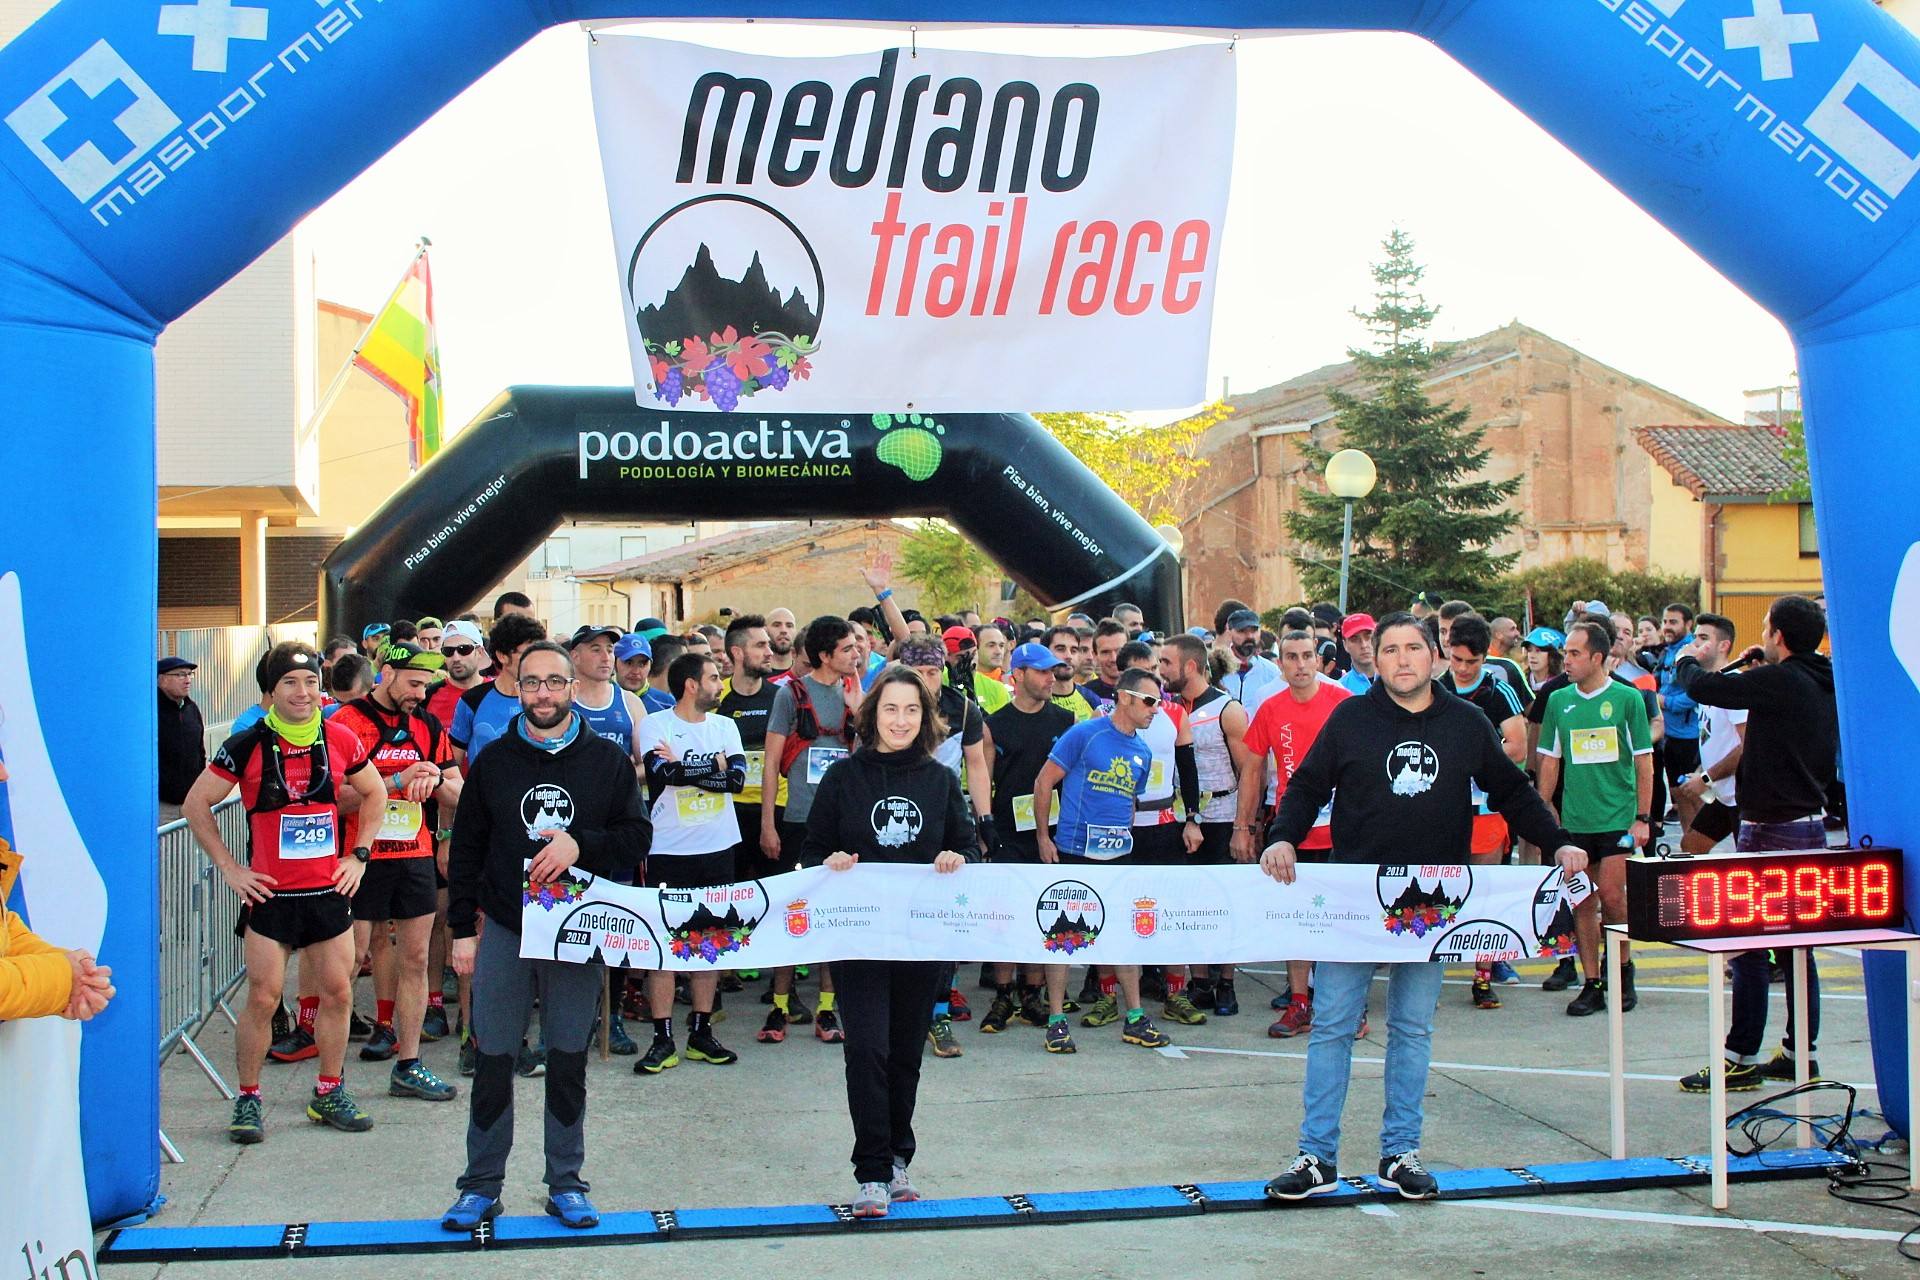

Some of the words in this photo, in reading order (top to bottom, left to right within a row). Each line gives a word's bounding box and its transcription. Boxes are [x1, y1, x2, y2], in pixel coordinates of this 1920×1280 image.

[676, 48, 1100, 193] medrano
[865, 193, 1028, 317] trail
[1038, 219, 1210, 316] race
[620, 463, 715, 479] PODOLOGÍA
[721, 466, 729, 478] Y
[736, 462, 852, 478] BIOMECÁNICA
[1003, 465, 1026, 490] Pisa
[1026, 485, 1050, 513] bien,
[1052, 509, 1073, 531] vive
[1071, 528, 1104, 557] mejor
[404, 547, 430, 569] Pisa
[427, 525, 457, 549] bien,
[454, 503, 477, 525] vive
[475, 474, 506, 506] mejor
[1582, 739, 1606, 750] 469
[689, 797, 715, 811] 457
[295, 828, 327, 844] 249
[1097, 838, 1124, 849] 270
[1386, 866, 1405, 876] 2019
[1440, 866, 1462, 878] race
[667, 894, 689, 903] 2019
[705, 888, 727, 903] trail
[730, 887, 754, 902] race
[1050, 886, 1088, 901] medrano
[1691, 862, 1889, 927] 09:29:48
[814, 904, 881, 917] Ayuntamiento
[910, 909, 935, 919] Finca
[937, 909, 949, 919] de
[951, 909, 965, 919] los
[966, 911, 1016, 921] Arandinos
[1162, 907, 1229, 920] Ayuntamiento
[1265, 910, 1291, 920] Finca
[1292, 909, 1304, 919] de
[1306, 910, 1320, 920] los
[1321, 911, 1370, 921] Arandinos
[579, 911, 635, 935] medrano
[815, 920, 826, 928] de
[828, 917, 871, 928] Medrano
[1161, 922, 1172, 931] de
[1175, 921, 1218, 931] Medrano
[566, 932, 587, 944] 2019
[603, 932, 626, 950] trail
[627, 937, 650, 951] race
[1449, 929, 1508, 951] medrano
